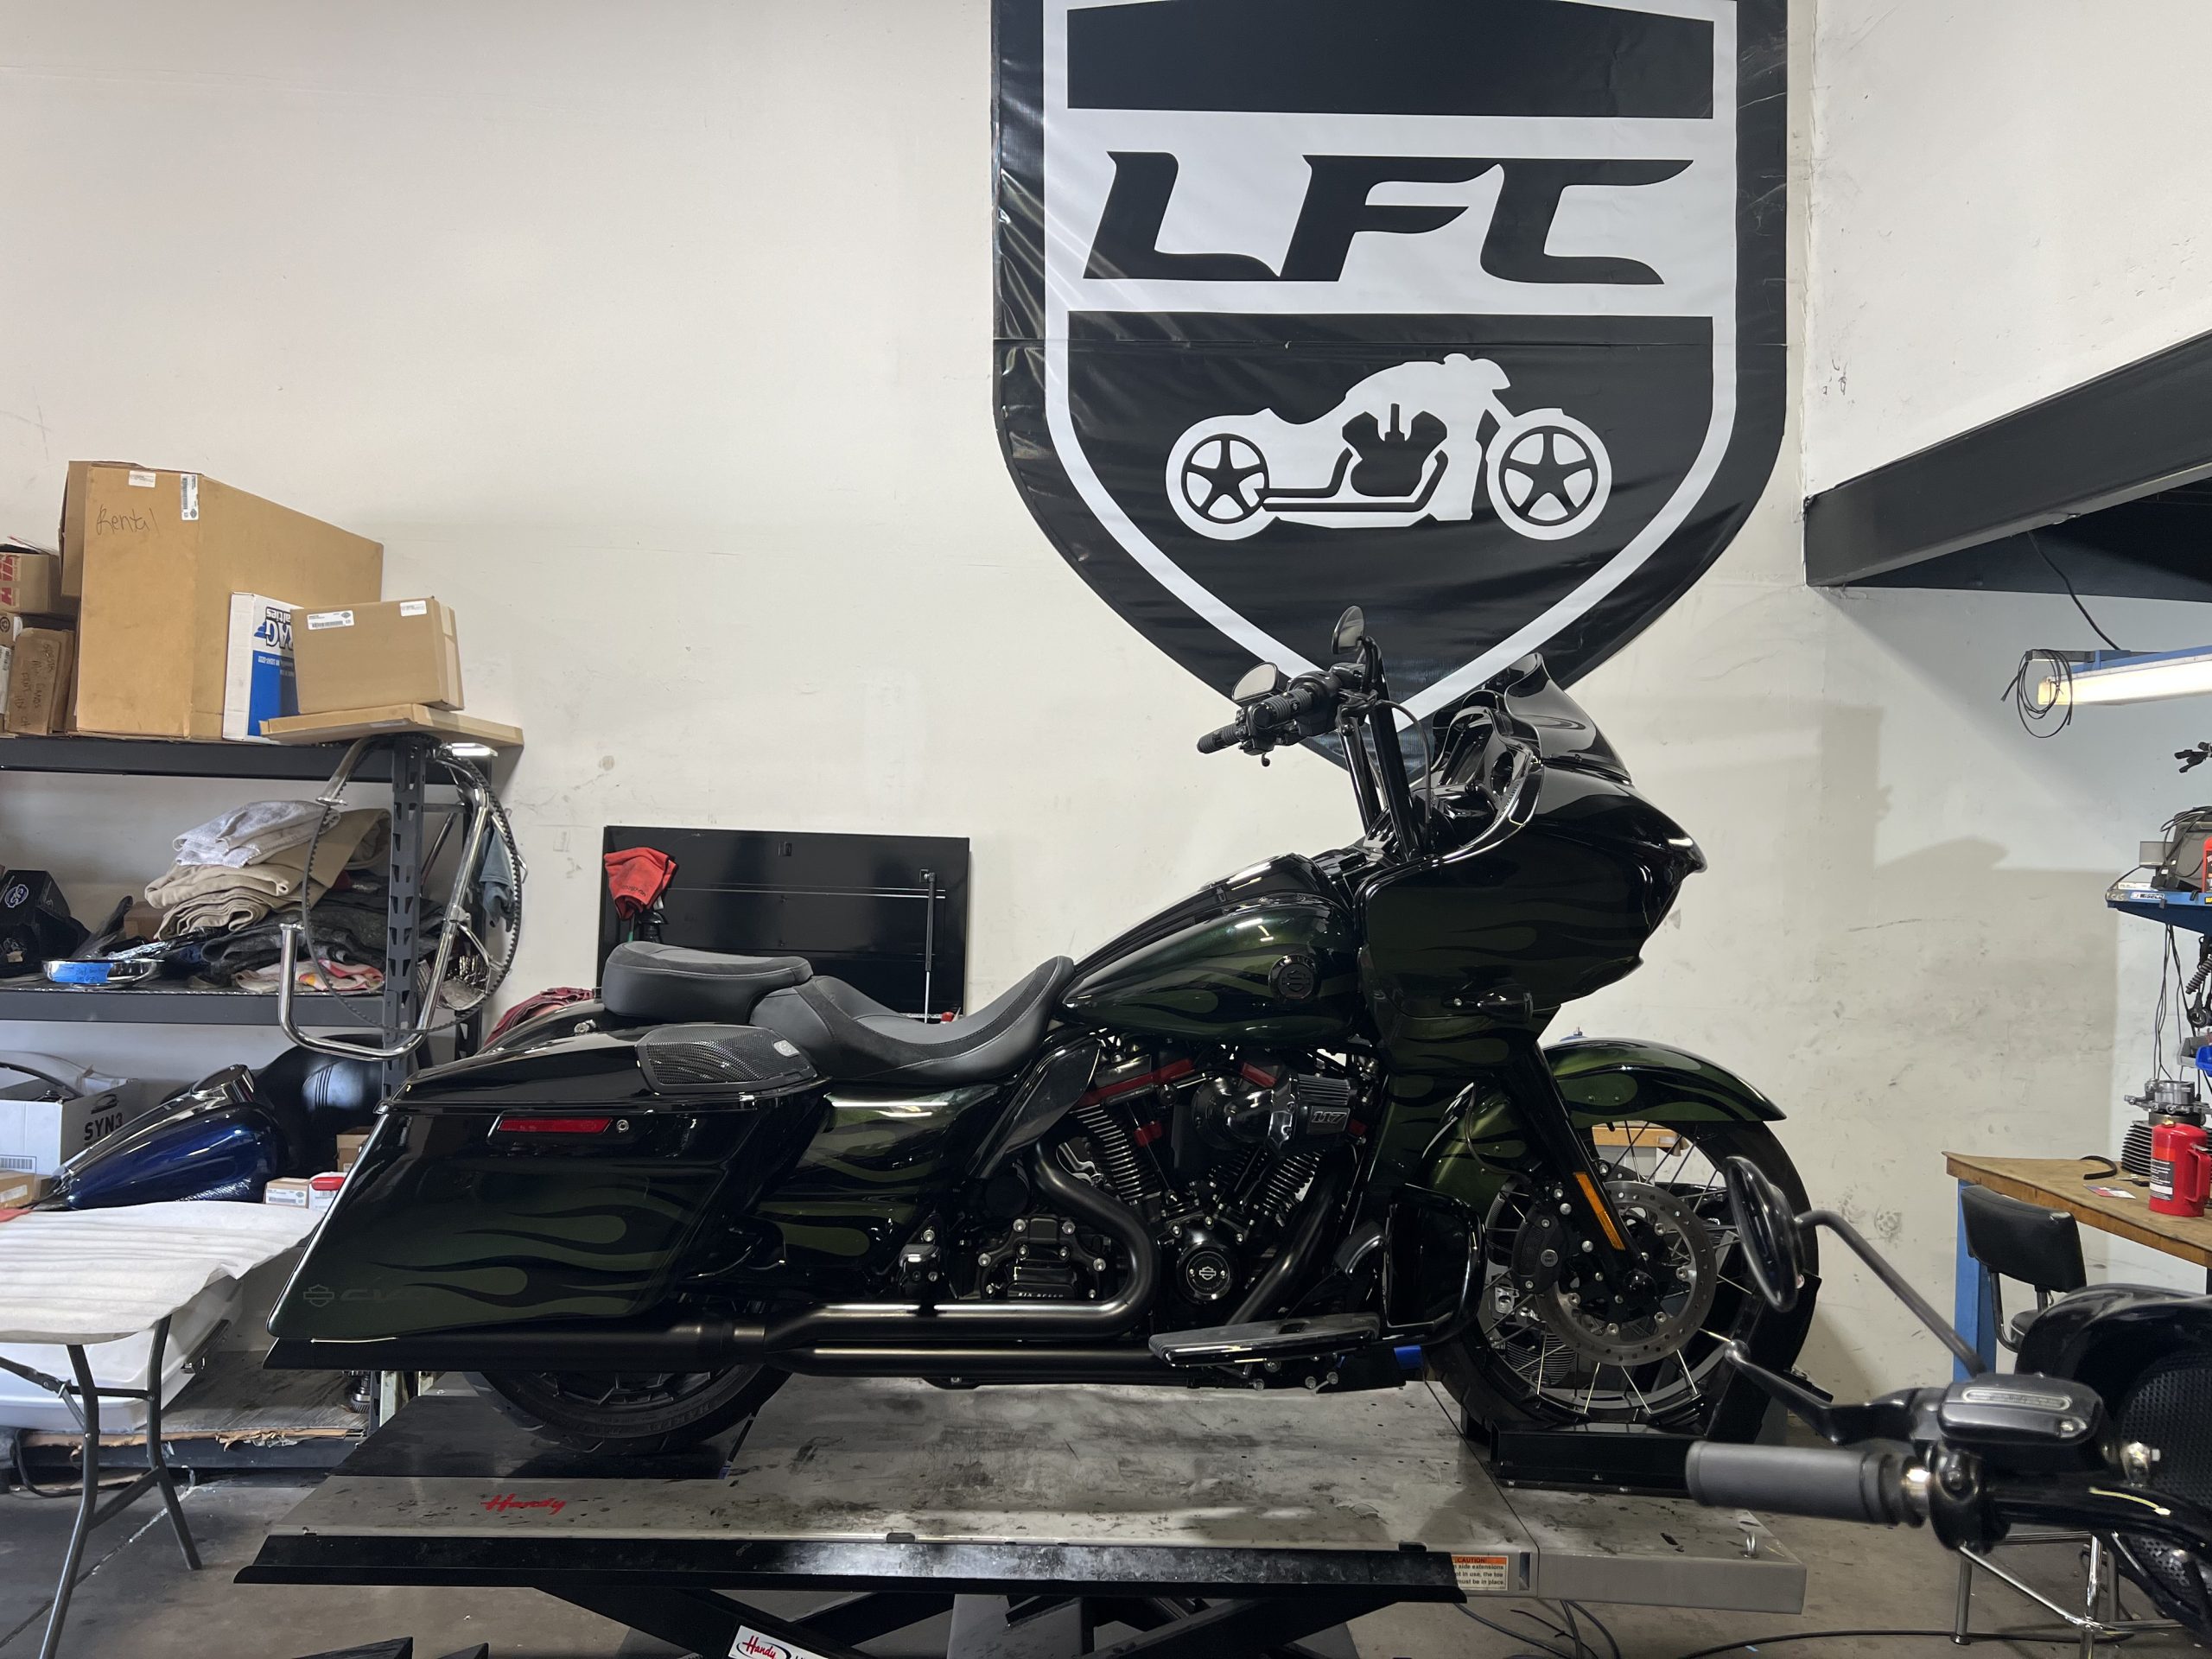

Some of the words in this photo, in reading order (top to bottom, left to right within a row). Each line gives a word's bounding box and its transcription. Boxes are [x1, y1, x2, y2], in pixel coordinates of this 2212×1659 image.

[1083, 150, 1694, 285] LFC
[96, 504, 160, 537] Rental
[266, 608, 290, 622] alties
[266, 619, 294, 651] RAG
[84, 1112, 123, 1141] SYN3
[1311, 1110, 1347, 1123] 117
[480, 1493, 567, 1516] Handy
[741, 1635, 776, 1659] Handy
